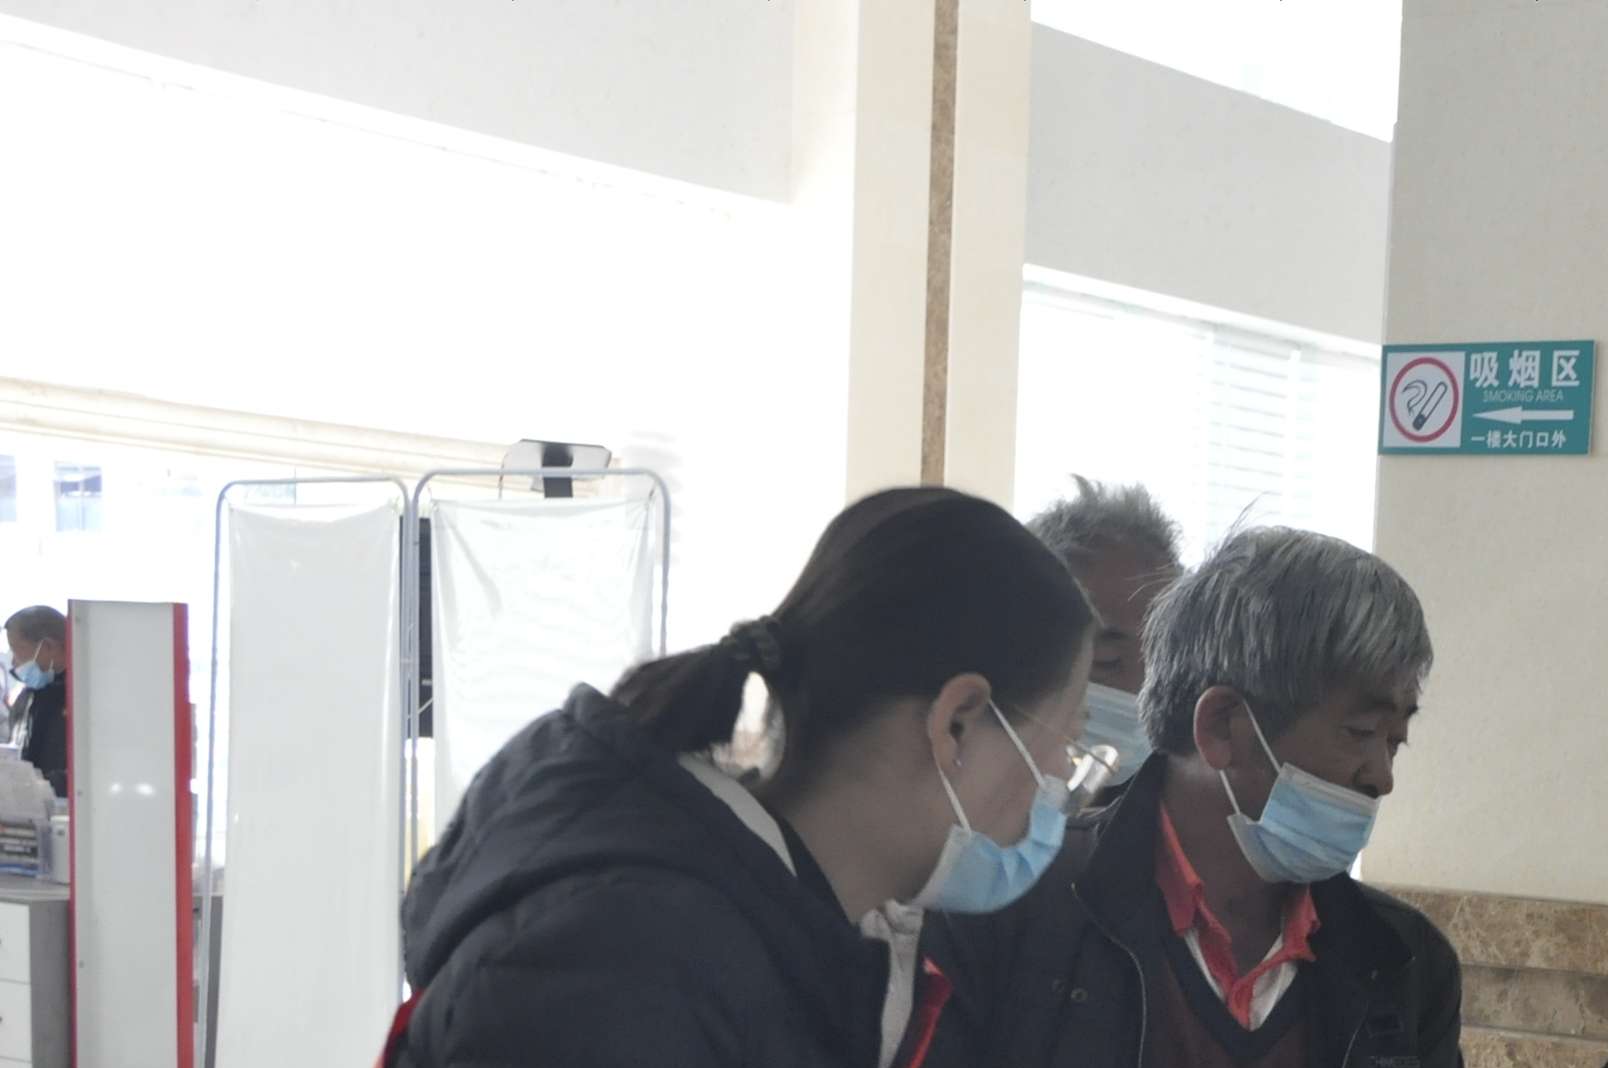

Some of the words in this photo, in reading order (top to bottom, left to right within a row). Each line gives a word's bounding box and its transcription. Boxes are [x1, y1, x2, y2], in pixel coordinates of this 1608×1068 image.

[1469, 350, 1580, 388] 吸烟区
[1483, 389, 1534, 402] SMOKING
[1535, 389, 1564, 402] AREA
[1470, 430, 1567, 448] 一楼大门口外
